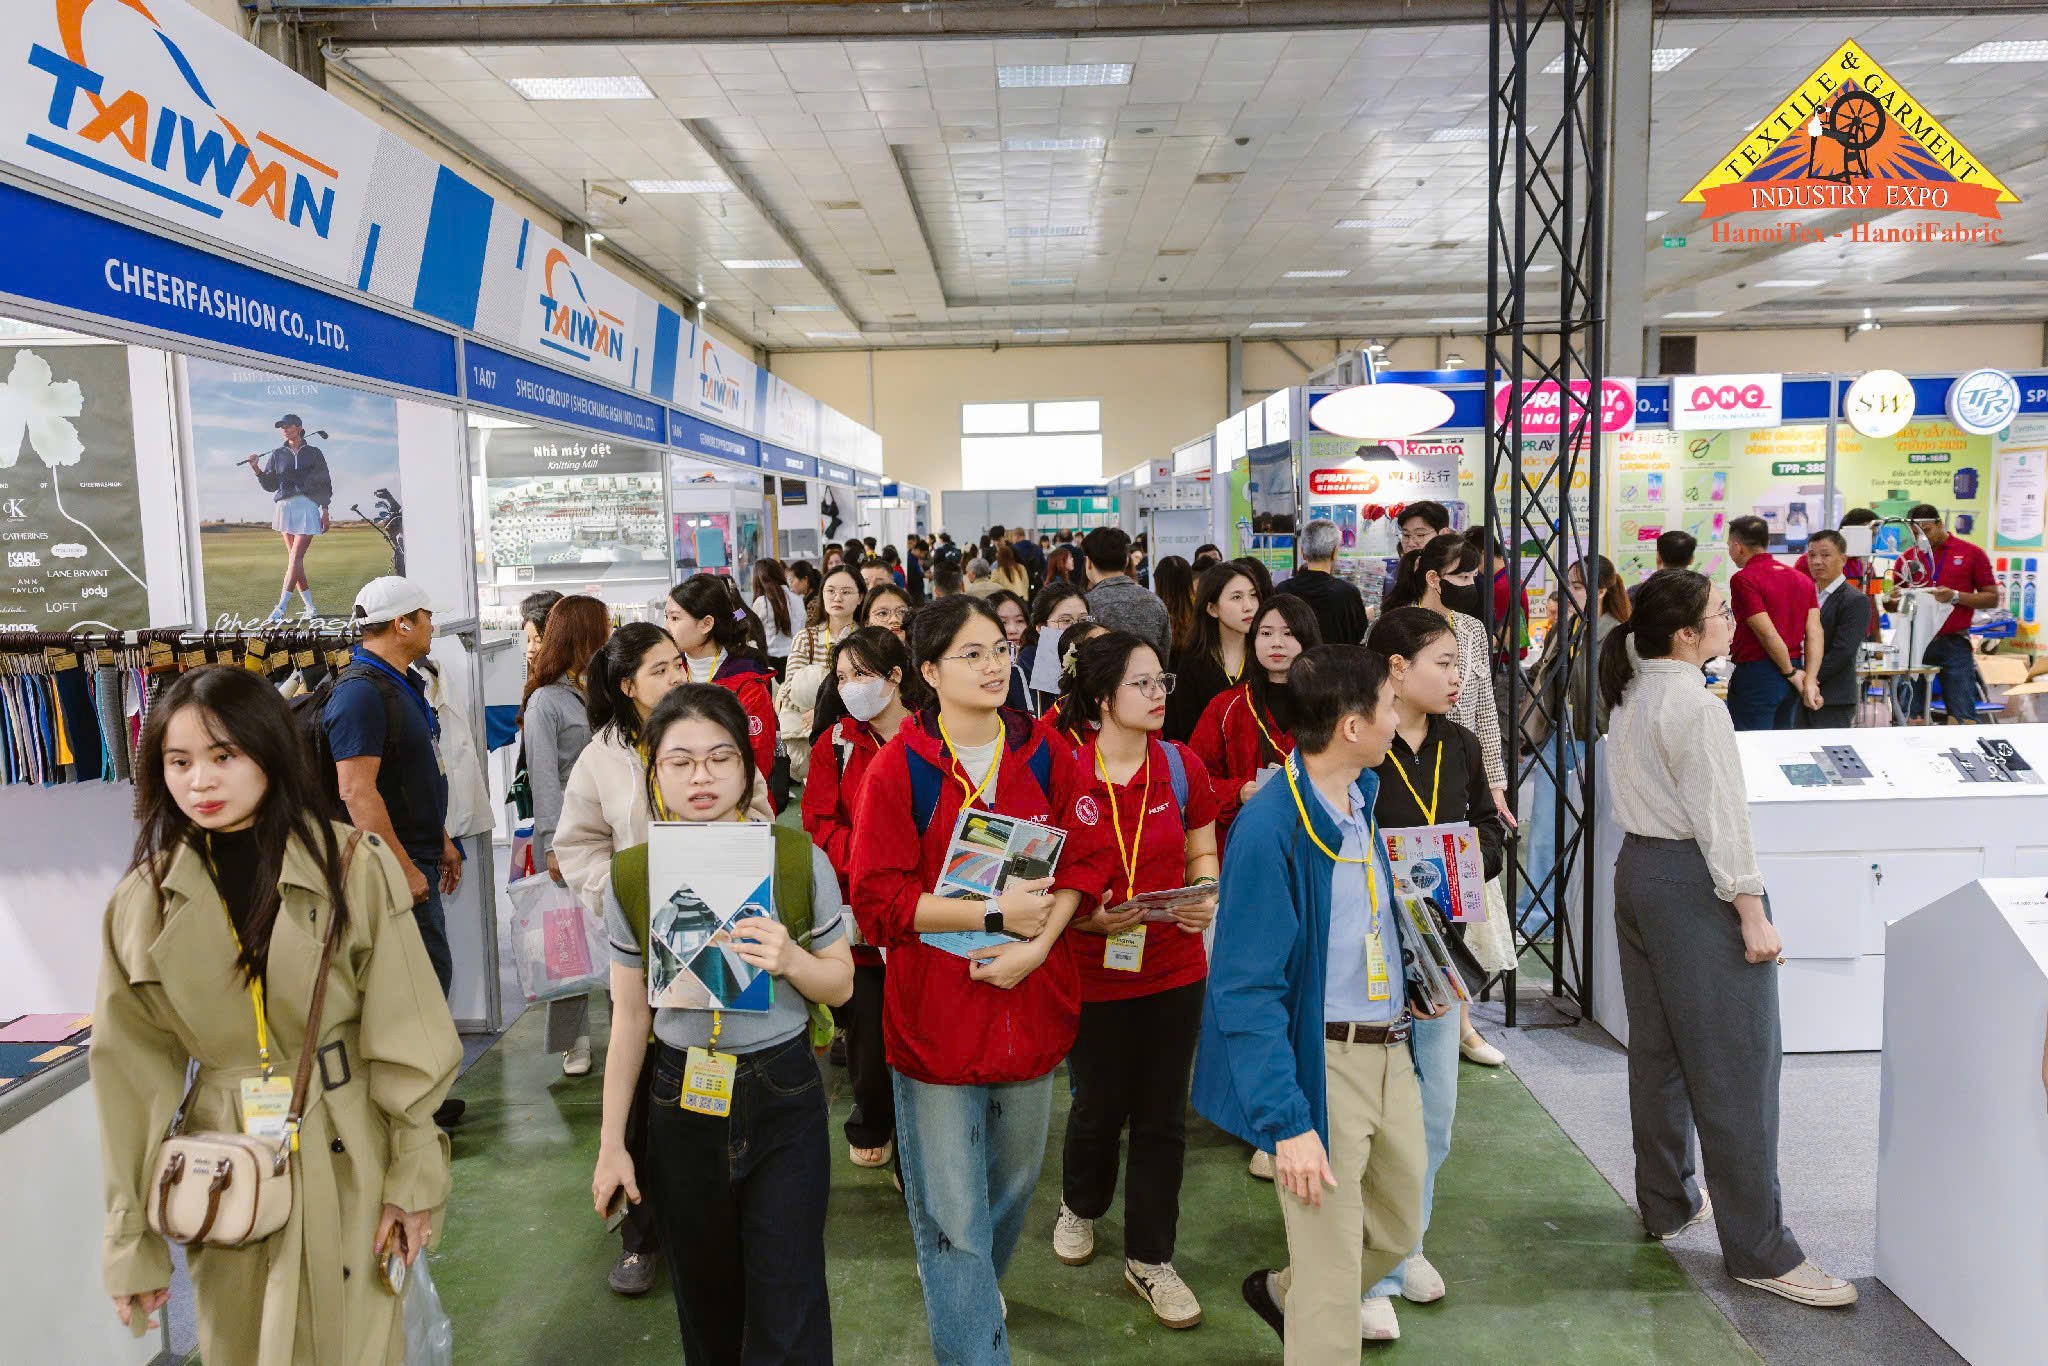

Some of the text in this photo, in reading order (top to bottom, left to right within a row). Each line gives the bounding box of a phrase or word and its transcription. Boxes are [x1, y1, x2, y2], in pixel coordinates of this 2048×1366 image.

[28, 42, 336, 240] TAIWAN
[104, 258, 349, 352] CHEERFASHION CO., LTD.
[540, 293, 623, 362] TAIWAN
[473, 366, 496, 390] 1A07
[301, 384, 318, 395] ON
[516, 379, 545, 403] SHEICO
[545, 387, 570, 409] GROUP
[700, 373, 739, 410] TAIWAN
[2026, 389, 2048, 403] SP
[533, 443, 612, 457] Nhà máy dệt
[547, 459, 599, 470] Knitting Mill
[2, 532, 49, 540] CATHERINES
[7, 551, 39, 560] KARL
[47, 570, 72, 578] LANE
[82, 584, 108, 598] yody
[46, 602, 78, 613] LOFT
[1149, 802, 1170, 815] HUST
